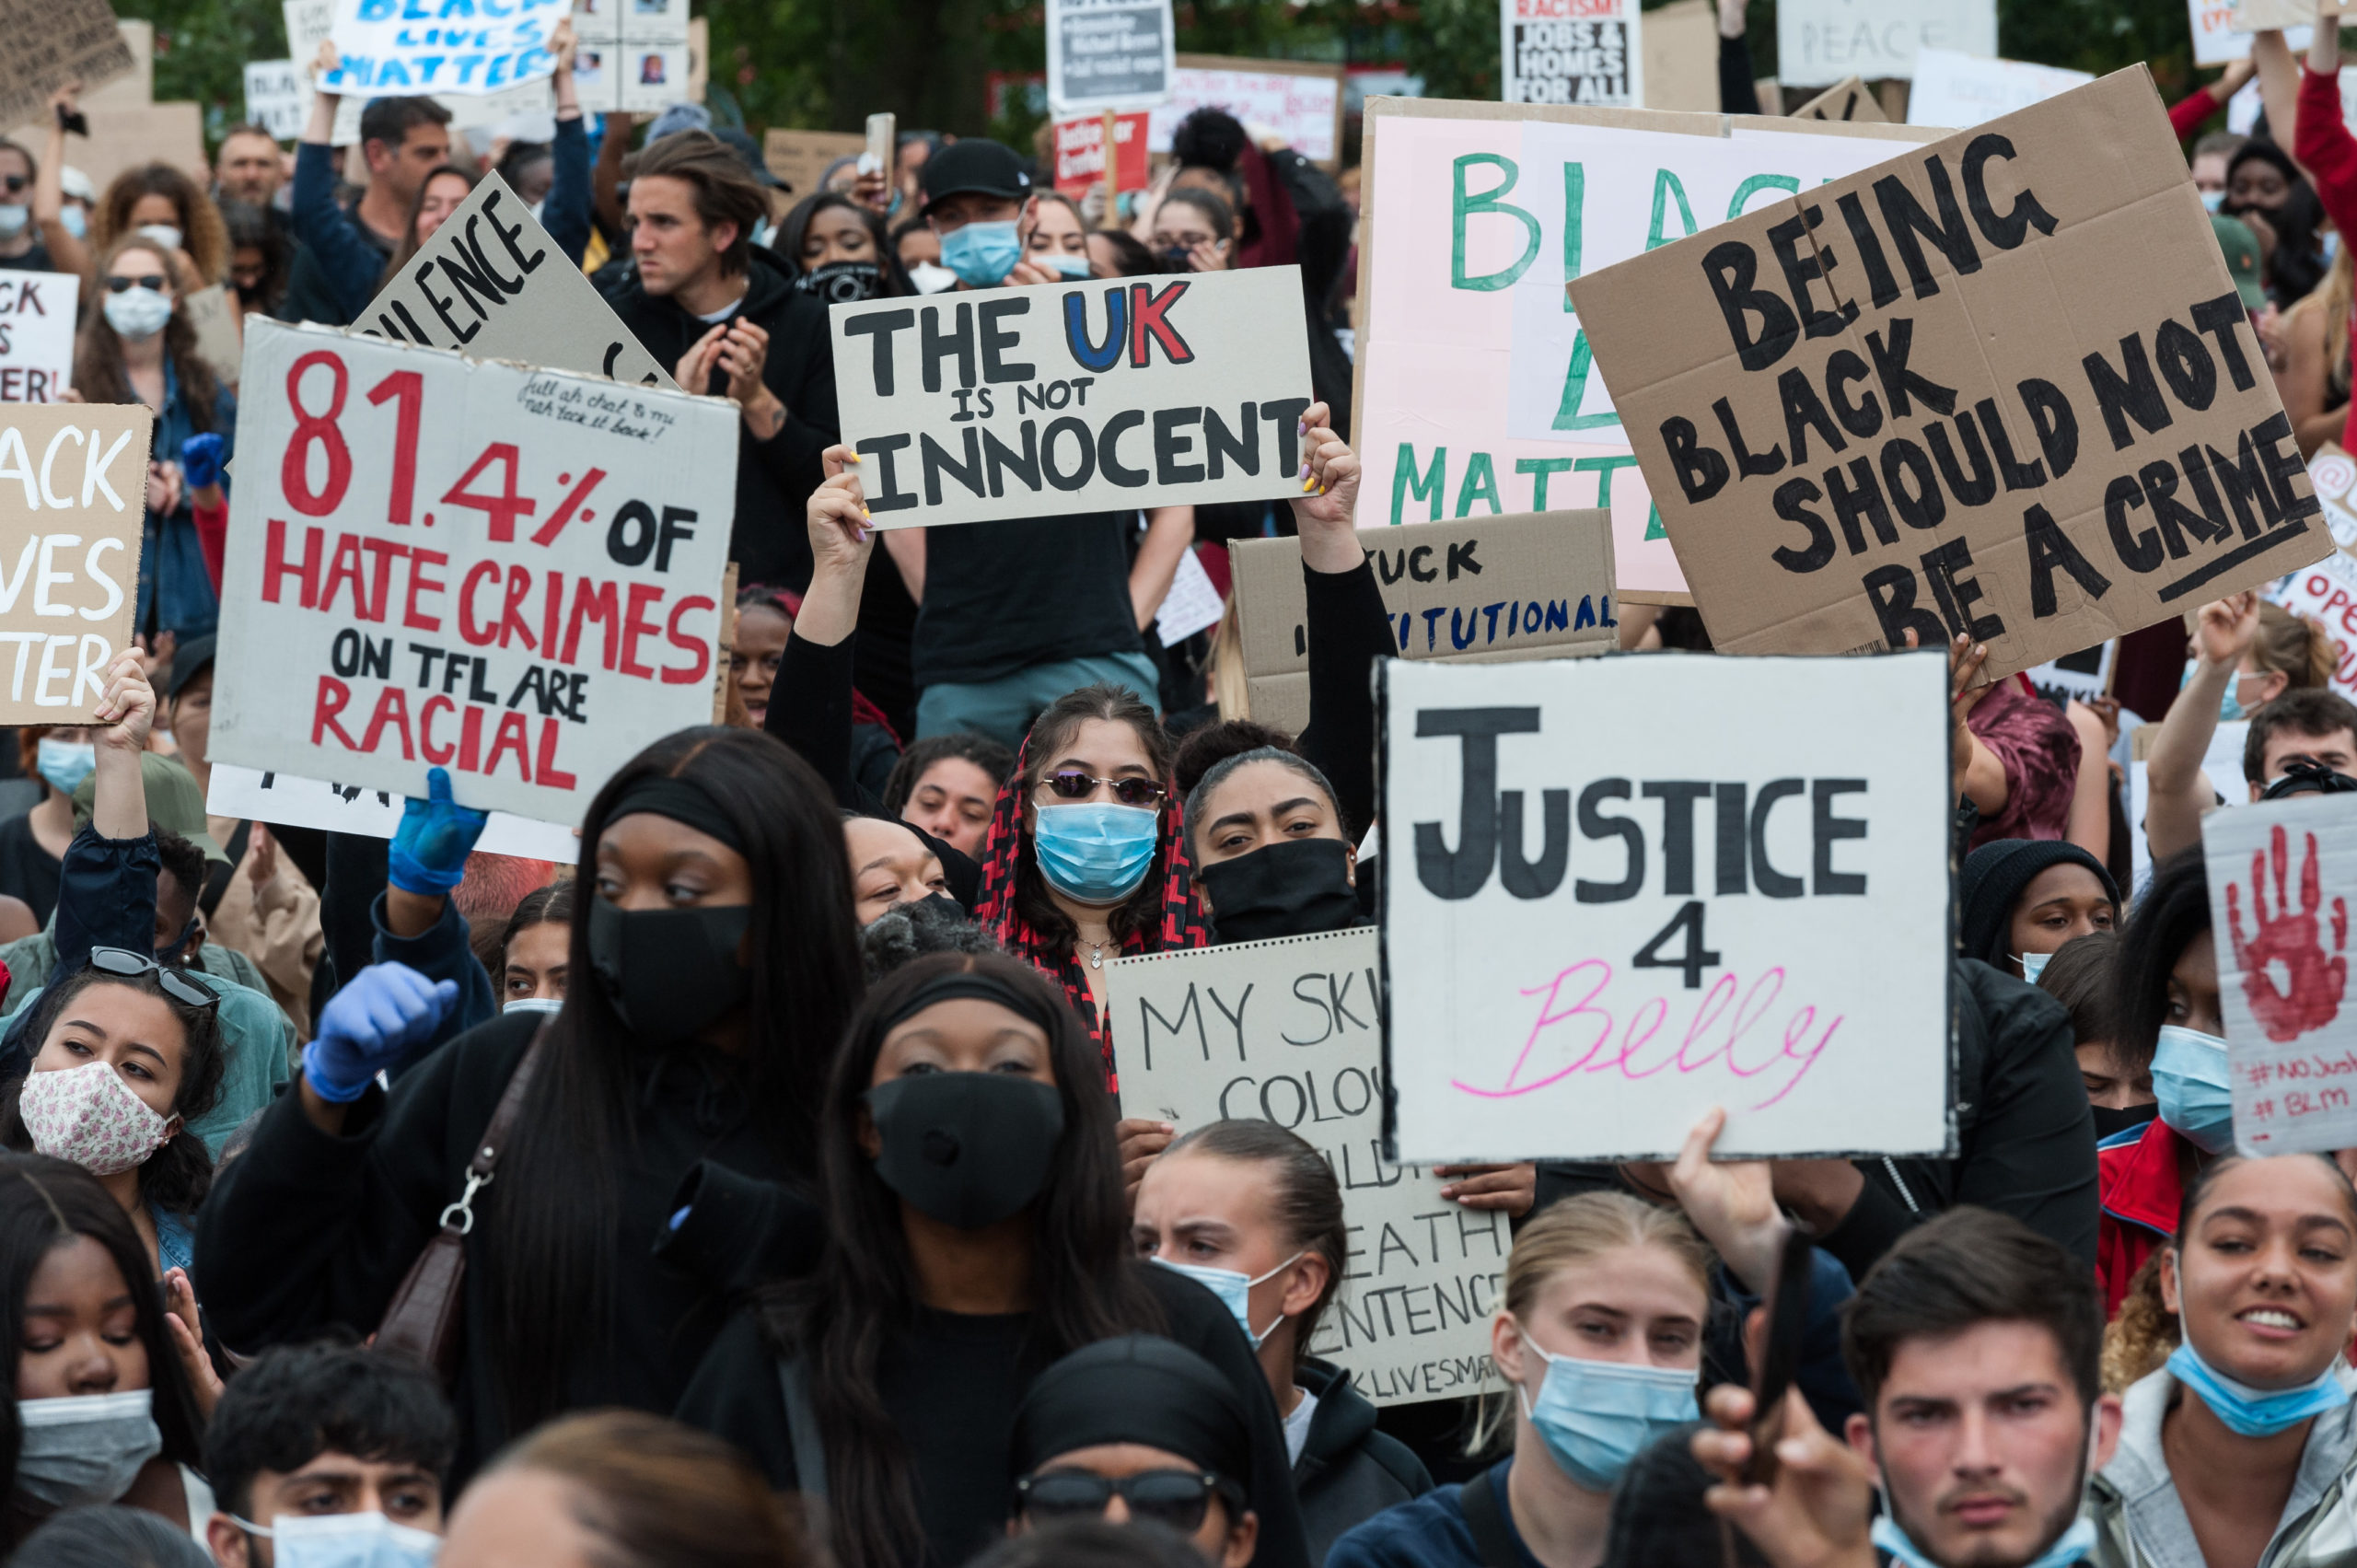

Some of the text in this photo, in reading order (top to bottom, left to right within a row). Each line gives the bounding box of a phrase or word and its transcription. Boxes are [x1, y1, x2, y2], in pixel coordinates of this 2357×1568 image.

[395, 18, 542, 46] LIVES
[1515, 0, 1622, 17] RACISM!
[1518, 21, 1623, 49] JOBS &
[326, 47, 555, 87] MATTER
[1516, 76, 1628, 103] FOR ALL
[1519, 49, 1623, 76] HOMES
[1113, 120, 1135, 143] or
[1701, 134, 2059, 371] BEING
[844, 281, 1196, 397] THE UK
[949, 377, 1096, 423] IS NOT
[1659, 318, 1958, 505] BLACK
[1771, 377, 2079, 574] SHOULD
[2082, 291, 2247, 452] NOT
[0, 424, 133, 512] ACK
[281, 350, 698, 573] 81.4% OF
[855, 397, 1311, 515] INNOCENT
[1861, 410, 2323, 650] BE A CRIME
[261, 518, 448, 633] HATE
[459, 559, 715, 684] CRIMES
[331, 628, 589, 724] ON TFL ARE
[311, 674, 577, 791] RACIAL
[1631, 900, 1721, 989] 4
[1140, 981, 1254, 1071] MY
[1451, 958, 1845, 1111] Belly
